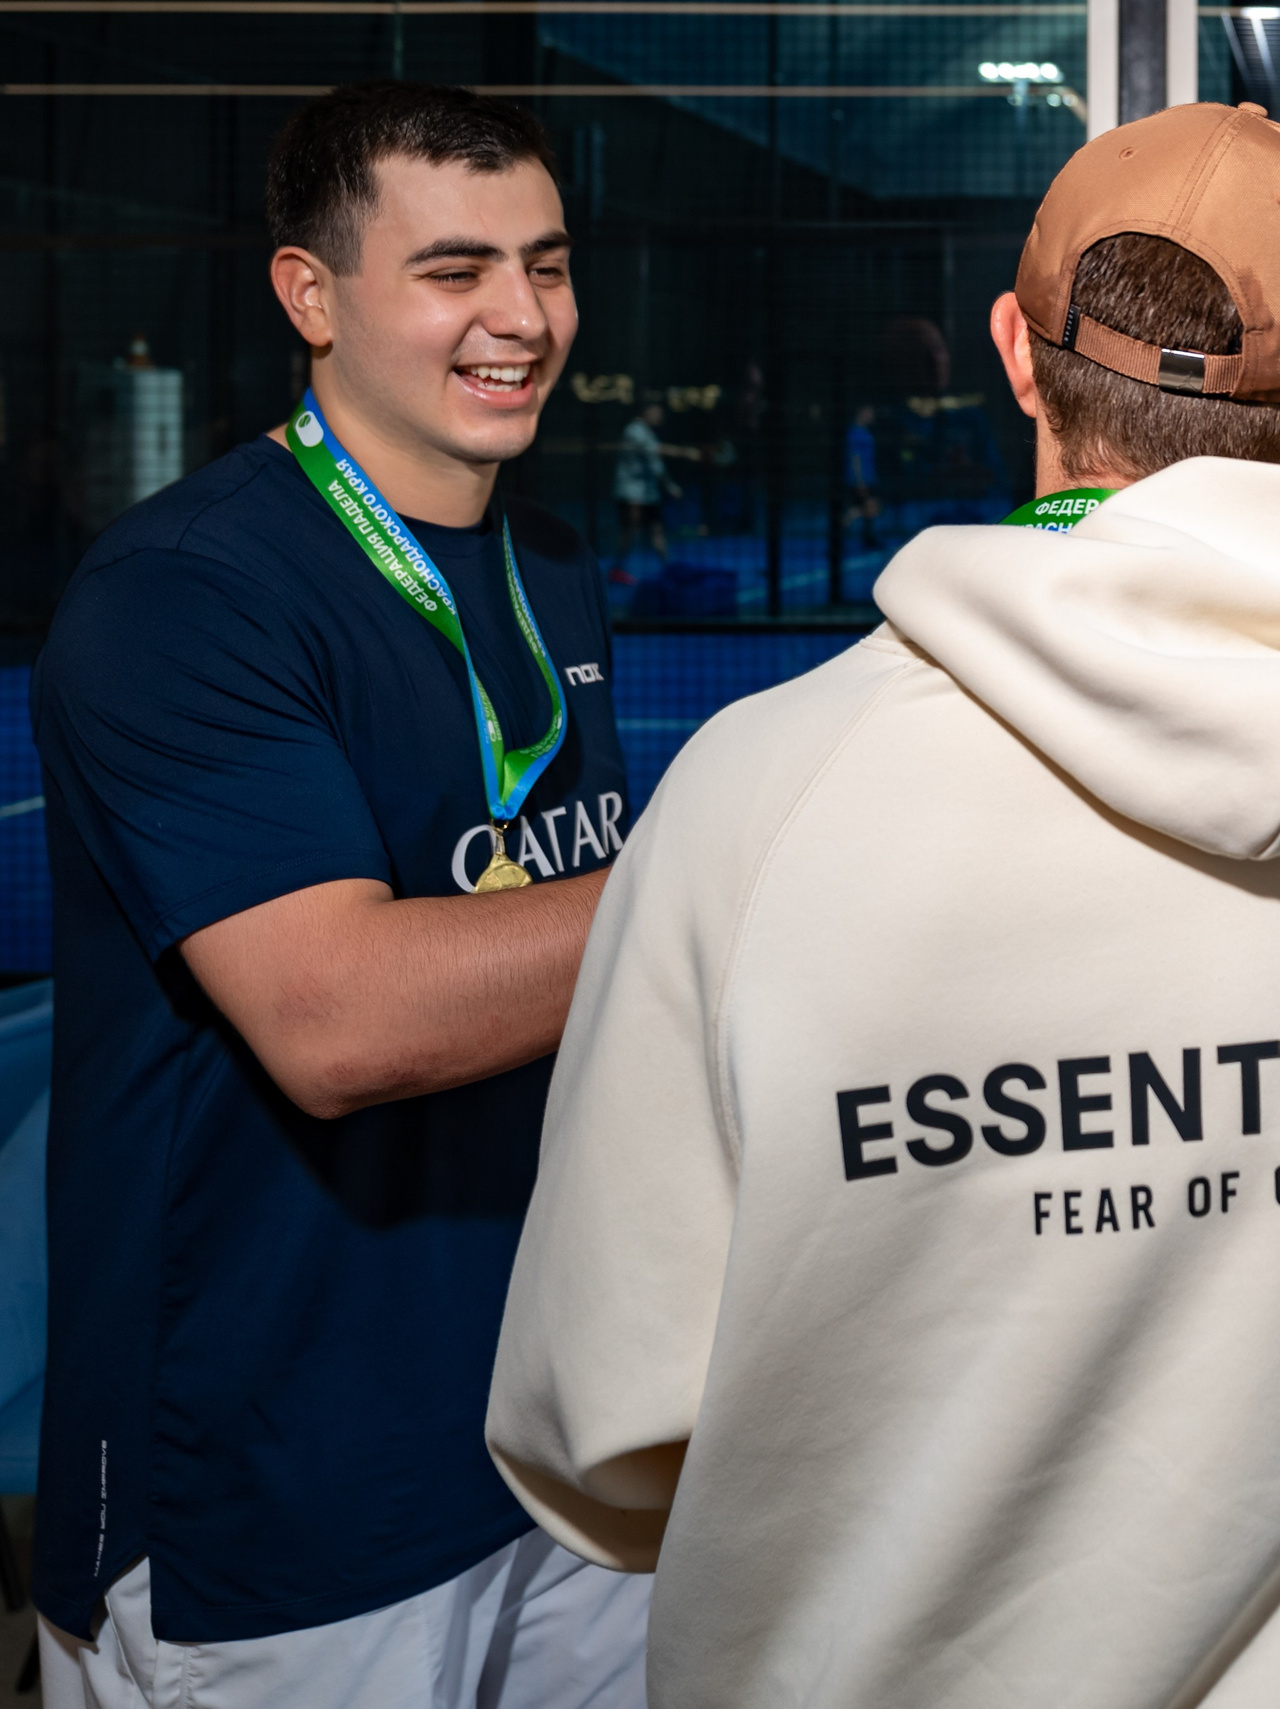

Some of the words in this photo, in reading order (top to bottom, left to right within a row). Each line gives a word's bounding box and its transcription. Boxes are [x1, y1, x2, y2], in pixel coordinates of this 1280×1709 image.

[327, 478, 374, 536] ПАДЕЛА
[335, 457, 369, 496] КРАЯ
[1035, 498, 1100, 516] ФЕДЕР
[362, 494, 458, 616] КРАСНОДАРСКОГО
[367, 530, 438, 612] ФЕДЕРАЦИЯ
[1033, 1185, 1156, 1235] FEAR
[1187, 1171, 1241, 1218] OF
